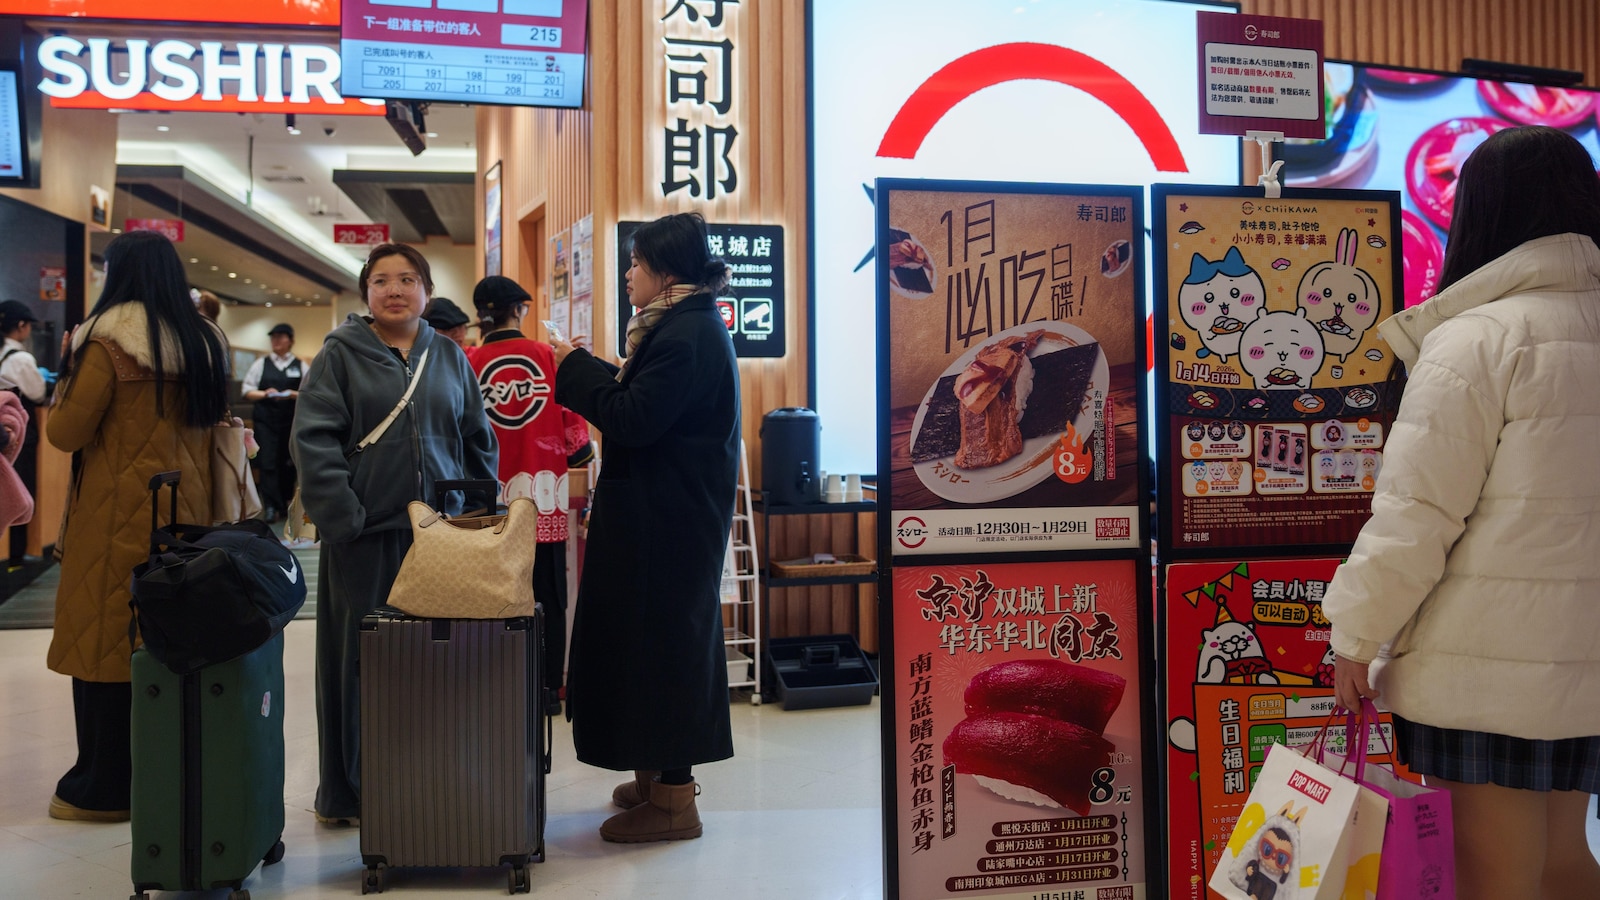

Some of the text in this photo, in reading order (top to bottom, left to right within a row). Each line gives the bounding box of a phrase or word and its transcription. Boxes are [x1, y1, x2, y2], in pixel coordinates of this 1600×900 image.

[363, 15, 481, 37] 下一组准备带位的客人
[530, 27, 558, 42] 215
[1261, 29, 1281, 39] 寿司郎
[363, 47, 434, 60] 已完成叫号的客人
[37, 35, 385, 105] SUSHIR
[378, 65, 560, 85] 7091 191 198 199 201
[383, 79, 560, 97] 205 207 211 208 214
[1076, 203, 1126, 223] 寿司郎
[940, 199, 995, 268] 1月
[1176, 361, 1240, 385] 1月14日开始
[481, 380, 549, 404] スシロー
[930, 461, 970, 485] スシロー
[1058, 452, 1086, 476] 8元
[896, 527, 929, 538] スシロー
[1097, 518, 1129, 528] 数量有限
[1097, 527, 1129, 537] 售完即止
[1183, 532, 1210, 542] 寿司郎
[917, 570, 1098, 623] 京沪双城上新
[1252, 579, 1331, 602] 会员小程
[939, 614, 1122, 662] 华东华北同庆
[1253, 699, 1281, 709] 生日当月
[1218, 698, 1245, 795] 生日福利
[1253, 735, 1281, 744] 消费当天
[908, 652, 935, 855] 南方蓝鳍金枪鱼赤身
[1089, 767, 1132, 806] 8元
[1290, 772, 1329, 802] POP MART
[1190, 840, 1198, 871] HAPPY
[1097, 887, 1131, 898] 数量有限
